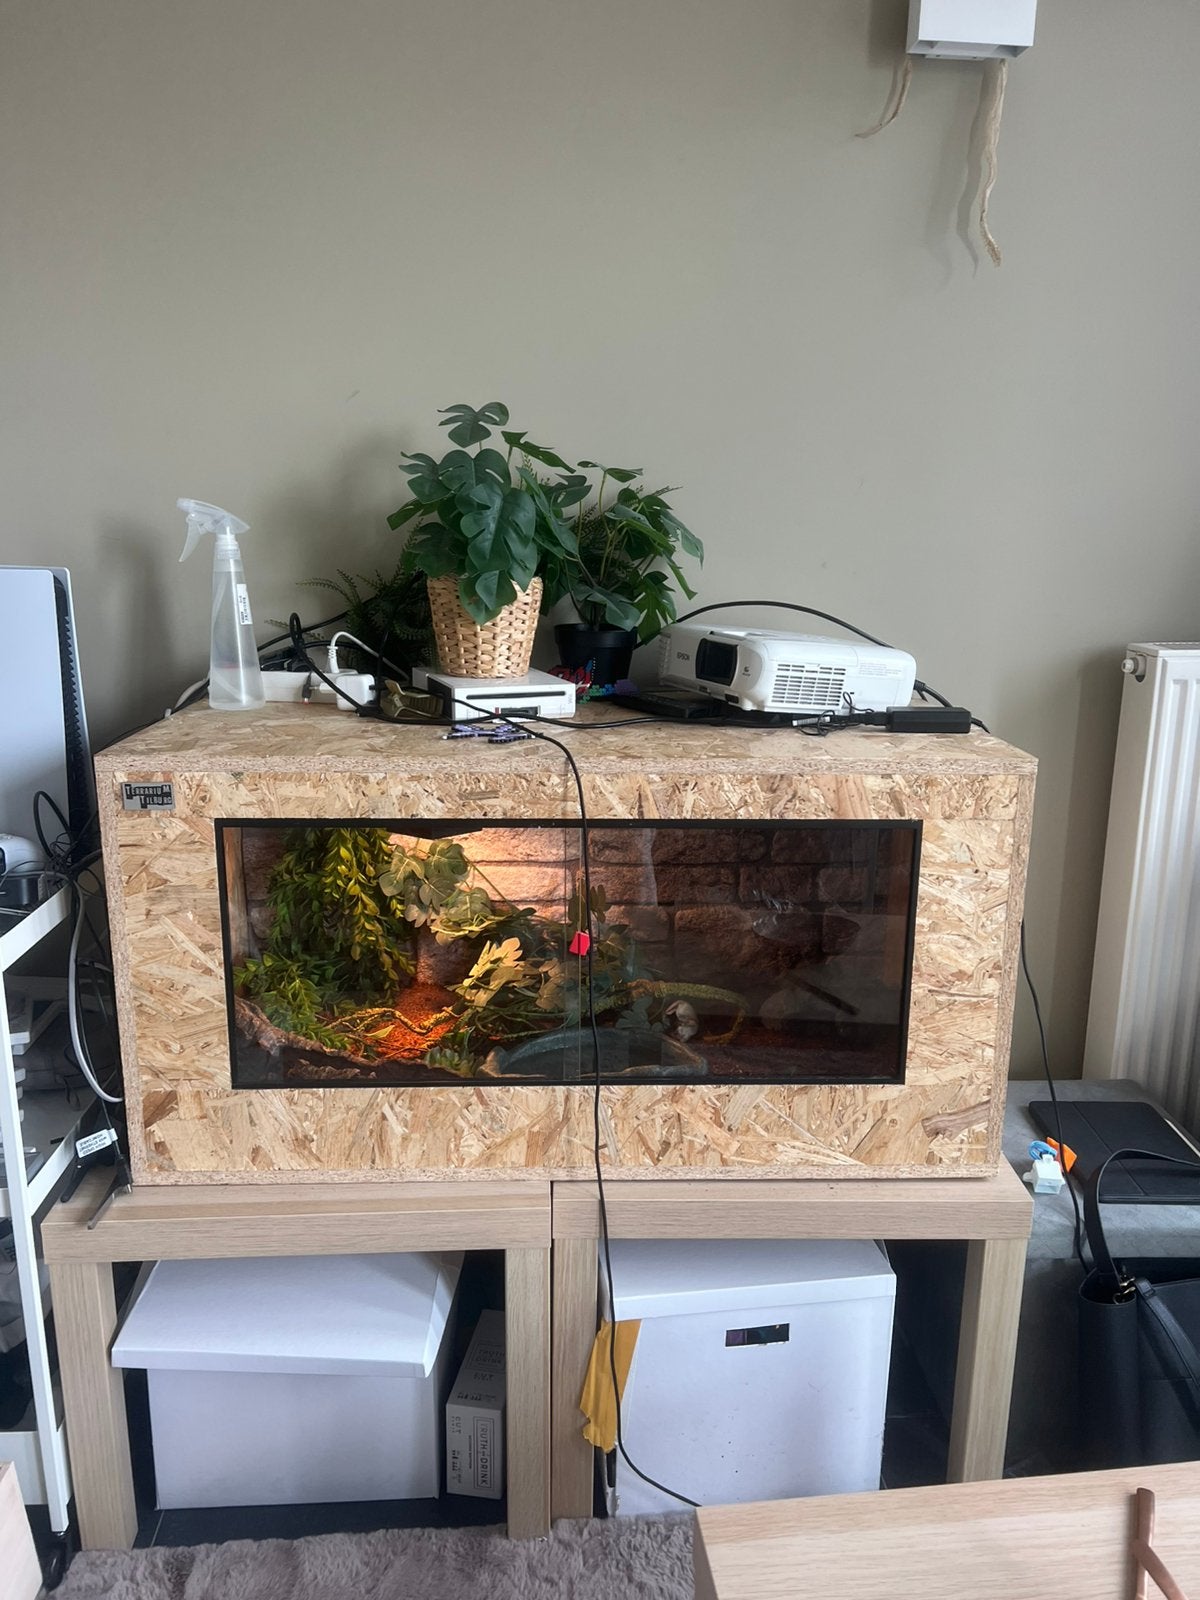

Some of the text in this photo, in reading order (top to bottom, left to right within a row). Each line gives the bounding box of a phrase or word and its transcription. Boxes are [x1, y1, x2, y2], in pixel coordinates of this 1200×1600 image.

[125, 785, 170, 795] TERRARIUM
[480, 1423, 488, 1452] TRUTH
[480, 1457, 488, 1486] DRINK
